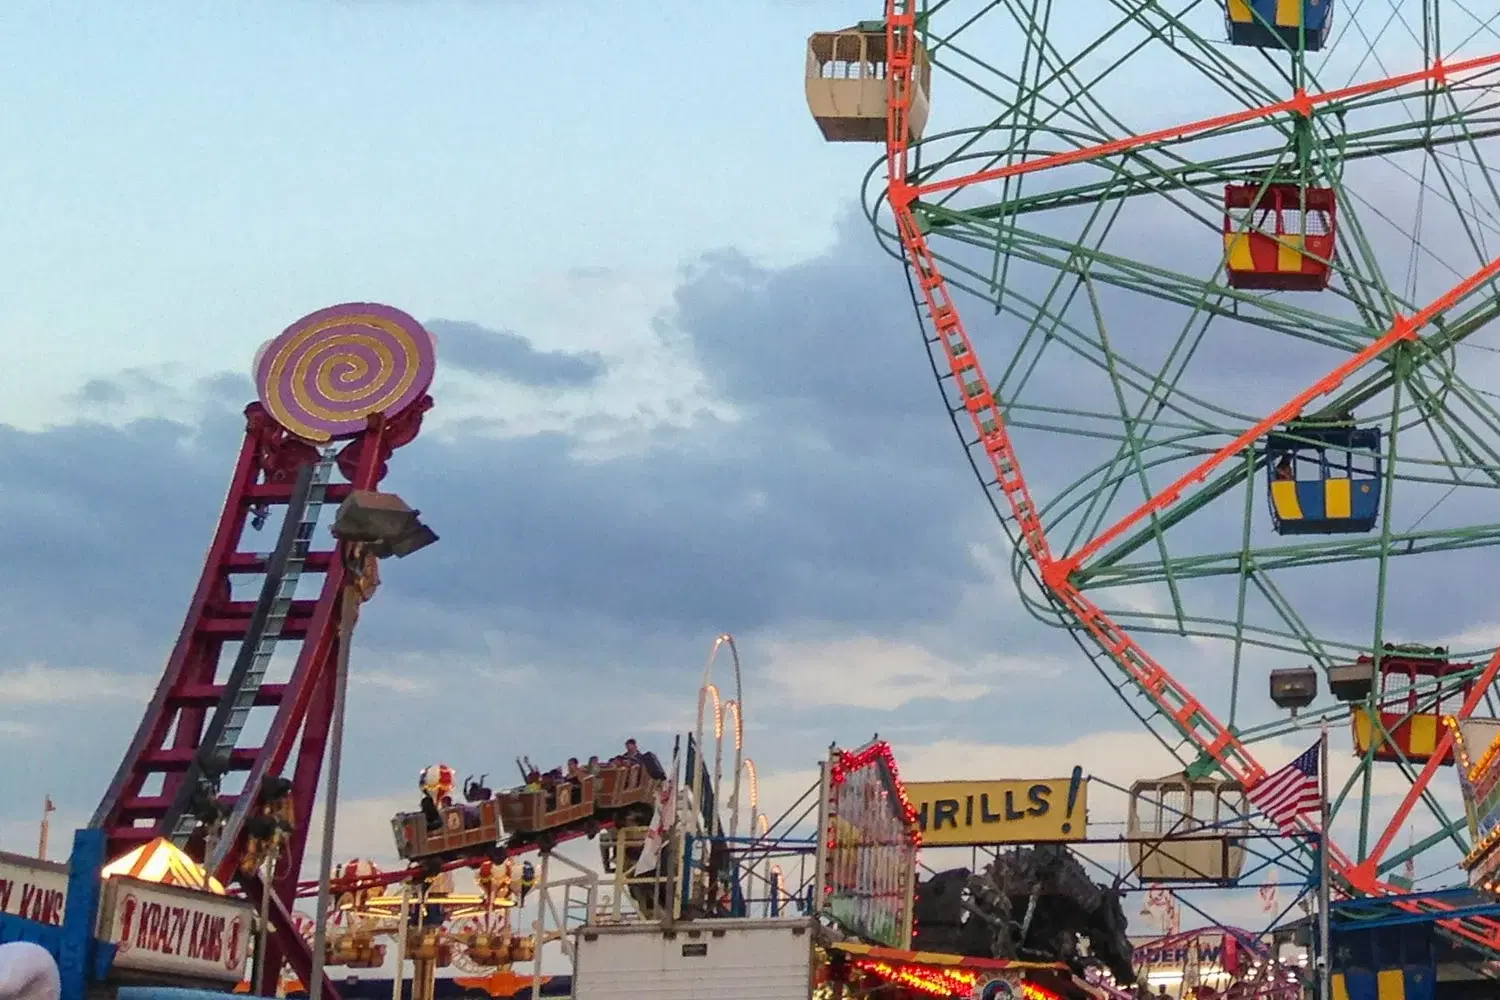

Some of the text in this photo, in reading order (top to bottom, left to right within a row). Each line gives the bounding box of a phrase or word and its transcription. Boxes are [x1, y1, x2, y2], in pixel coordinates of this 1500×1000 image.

[916, 765, 1083, 834] HRILLS!
[136, 901, 226, 962] KRAZY KANS
